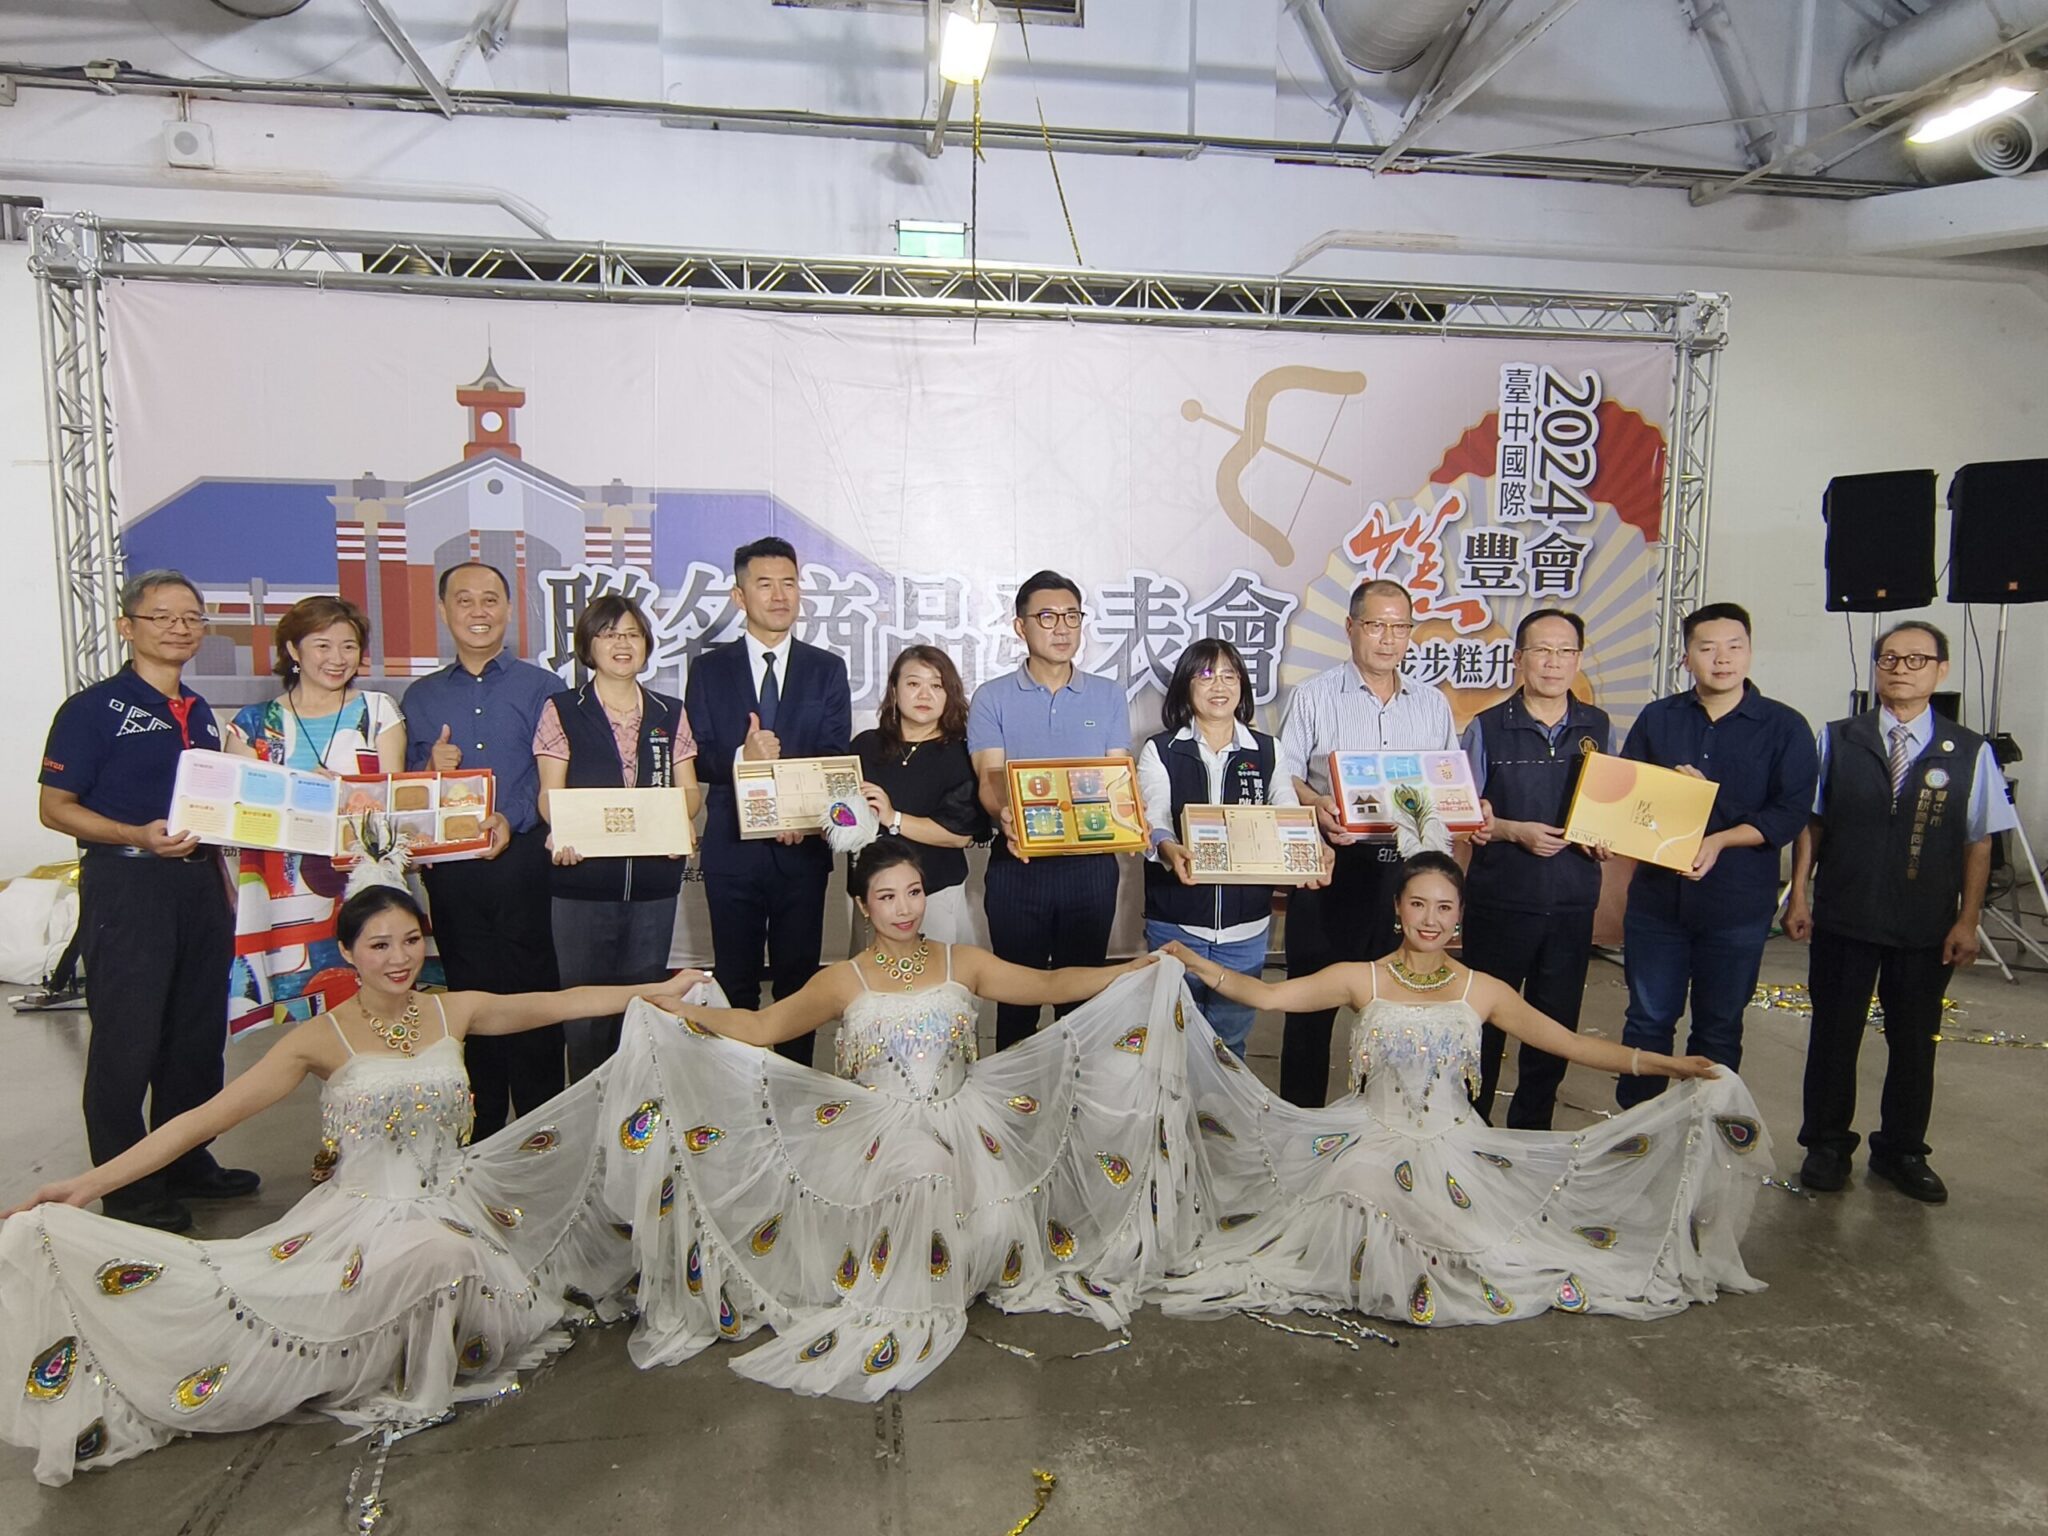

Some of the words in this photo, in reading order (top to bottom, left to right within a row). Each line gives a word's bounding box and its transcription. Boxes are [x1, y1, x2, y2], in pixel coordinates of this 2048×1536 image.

[1500, 368, 1532, 517] 臺中國際
[1531, 371, 1596, 520] 2024
